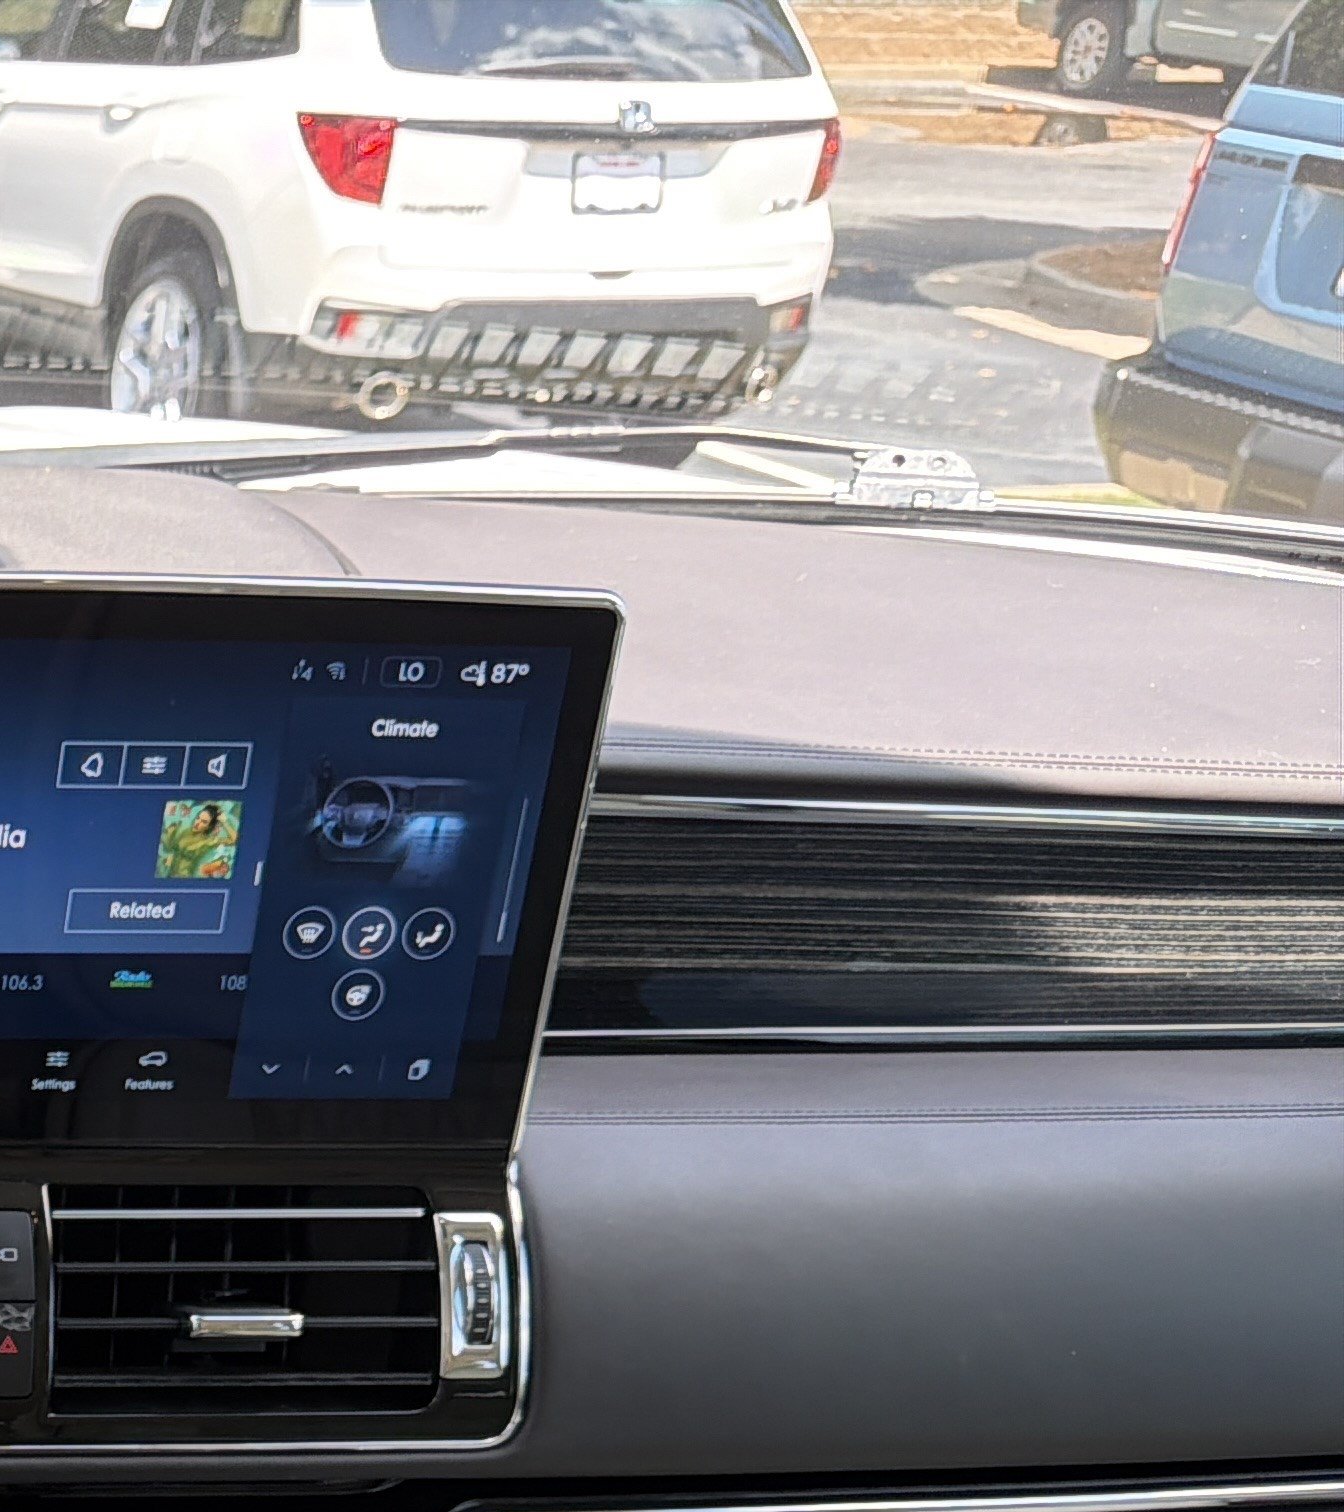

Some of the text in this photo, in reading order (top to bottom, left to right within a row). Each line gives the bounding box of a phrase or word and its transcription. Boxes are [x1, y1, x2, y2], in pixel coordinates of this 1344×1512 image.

[398, 662, 425, 682] LO
[371, 719, 440, 738] Climate
[109, 901, 176, 921] Related
[0, 974, 44, 992] 106.3
[31, 1078, 77, 1094] Settings
[124, 1077, 175, 1092] Features
